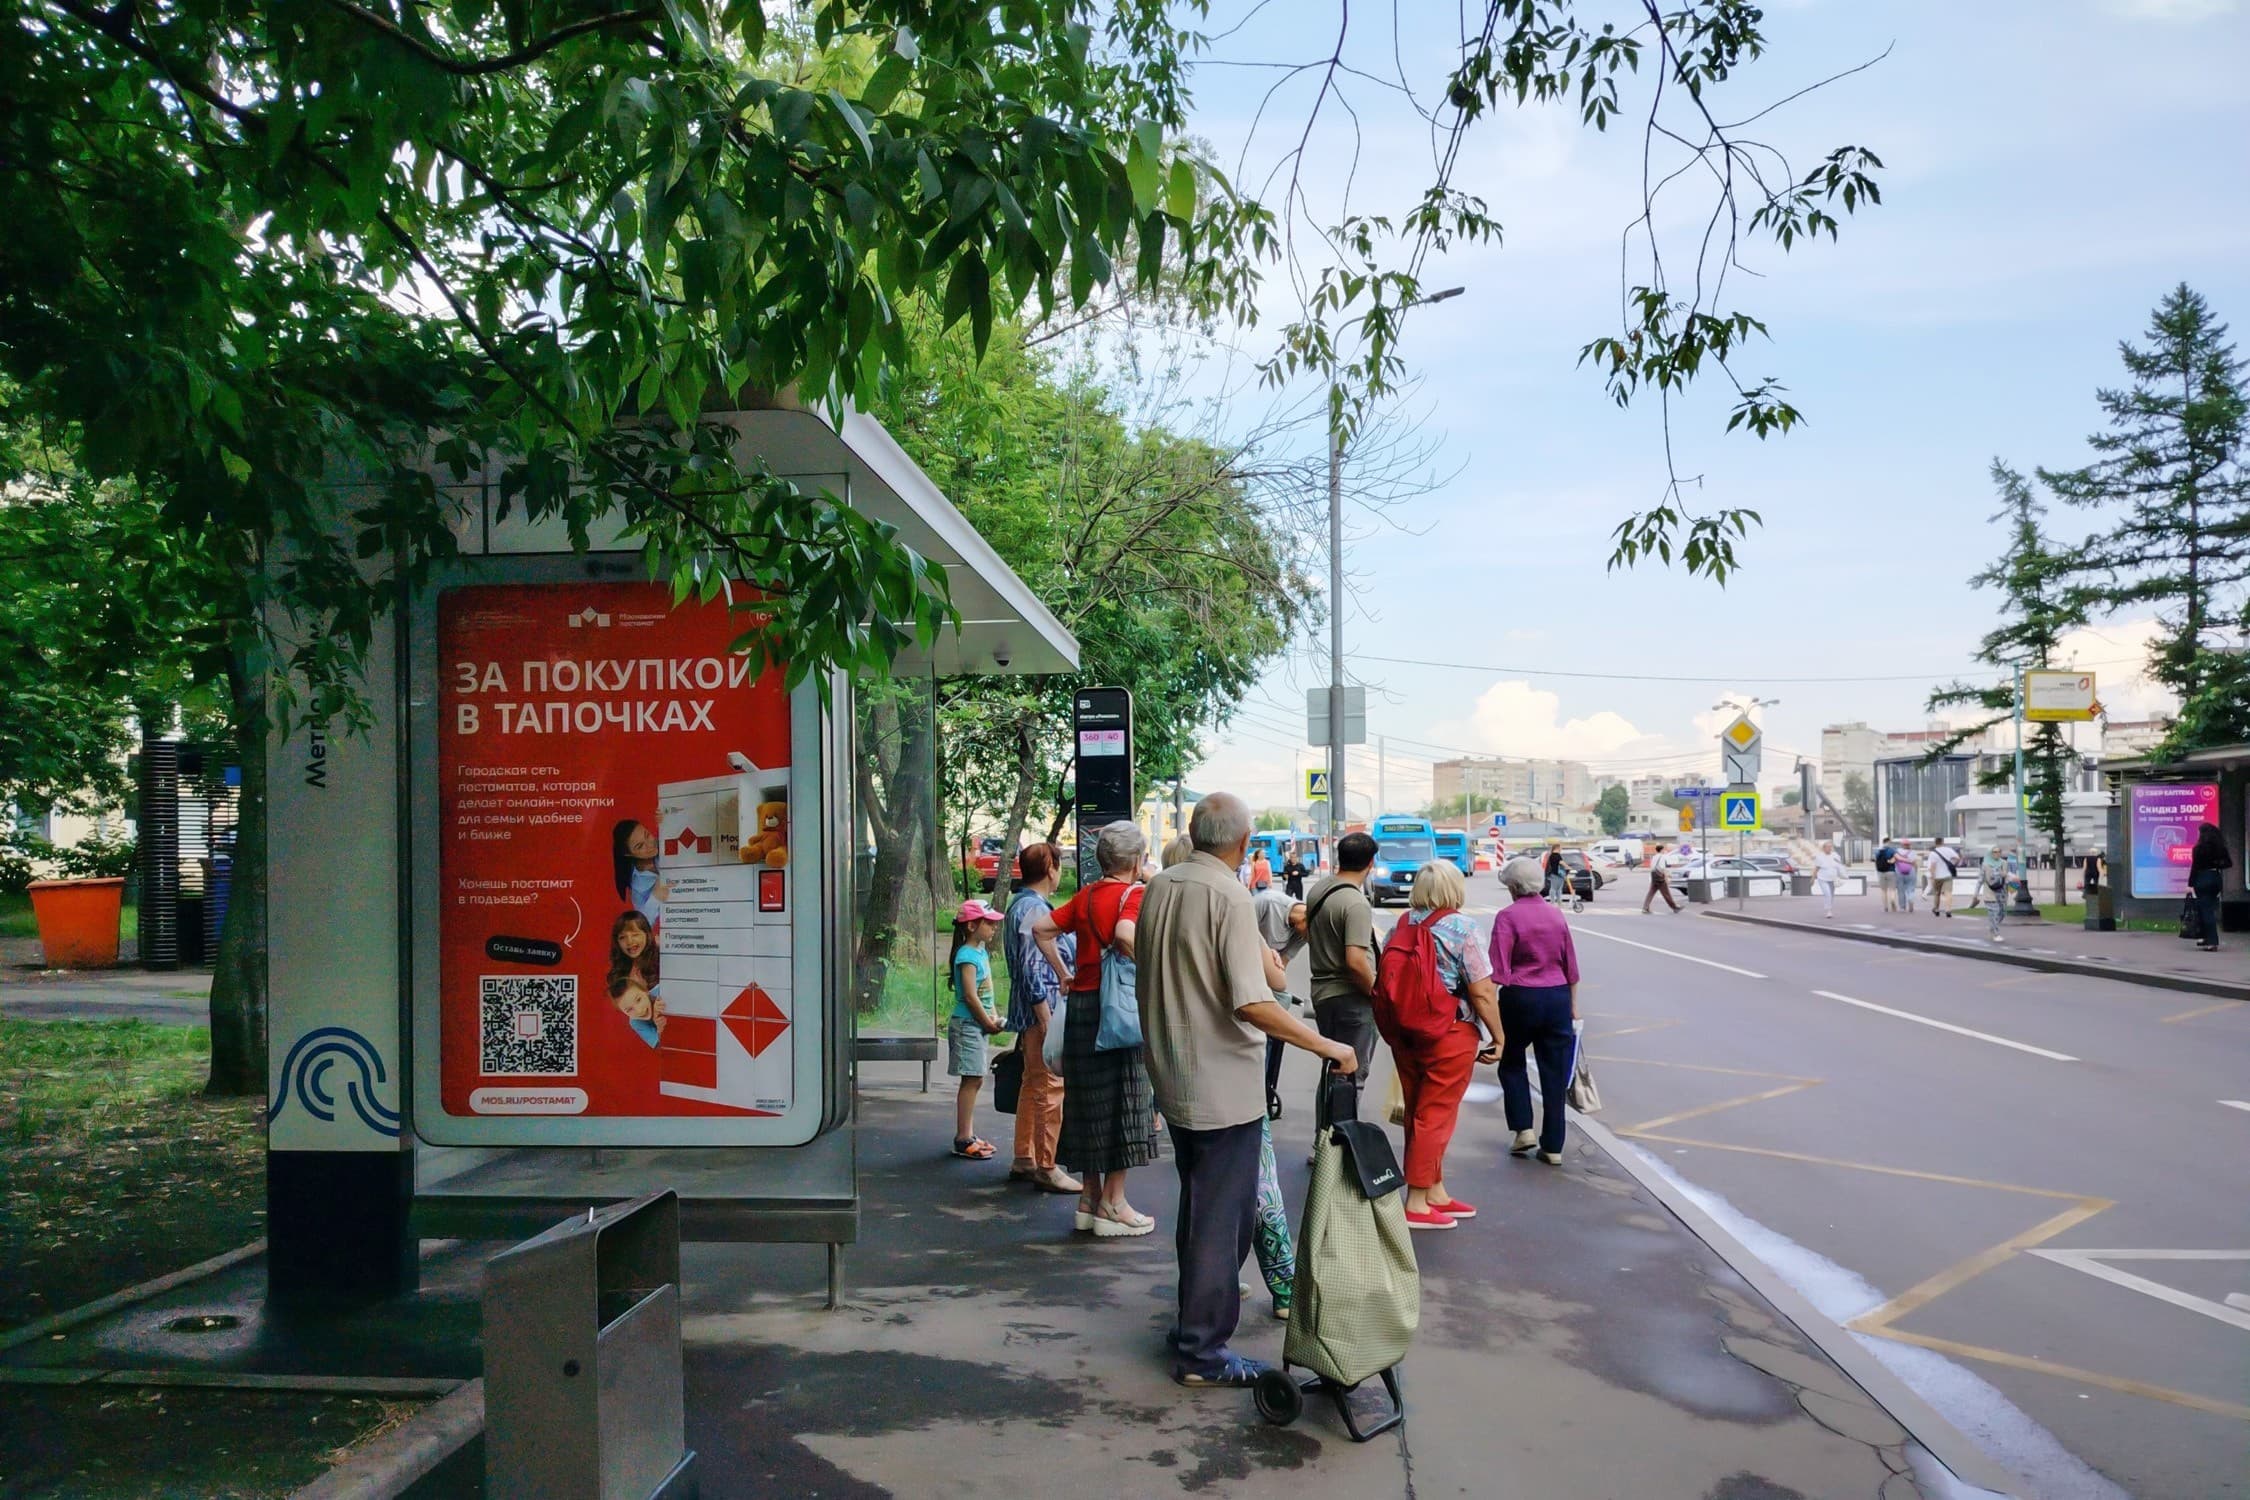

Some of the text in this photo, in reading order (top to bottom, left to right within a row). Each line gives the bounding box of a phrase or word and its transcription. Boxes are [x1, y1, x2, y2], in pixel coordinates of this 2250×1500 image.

[455, 647, 756, 694] ЗА ПОКУПКОЙ
[457, 700, 717, 734] В ТАПОЧКАХ
[458, 765, 560, 777] Городская сеть
[458, 781, 596, 793] постаматов, которая
[458, 796, 615, 809] делает онлайн-покупки
[2139, 805, 2178, 814] Скидка
[458, 812, 583, 825] для семьи удобнее
[458, 829, 512, 840] и ближе
[458, 878, 574, 889] Хочешь постамат
[458, 892, 539, 905] в подъезде?
[493, 943, 525, 954] Оставь
[481, 1096, 577, 1105] MOS.RU/POSTAMAT
